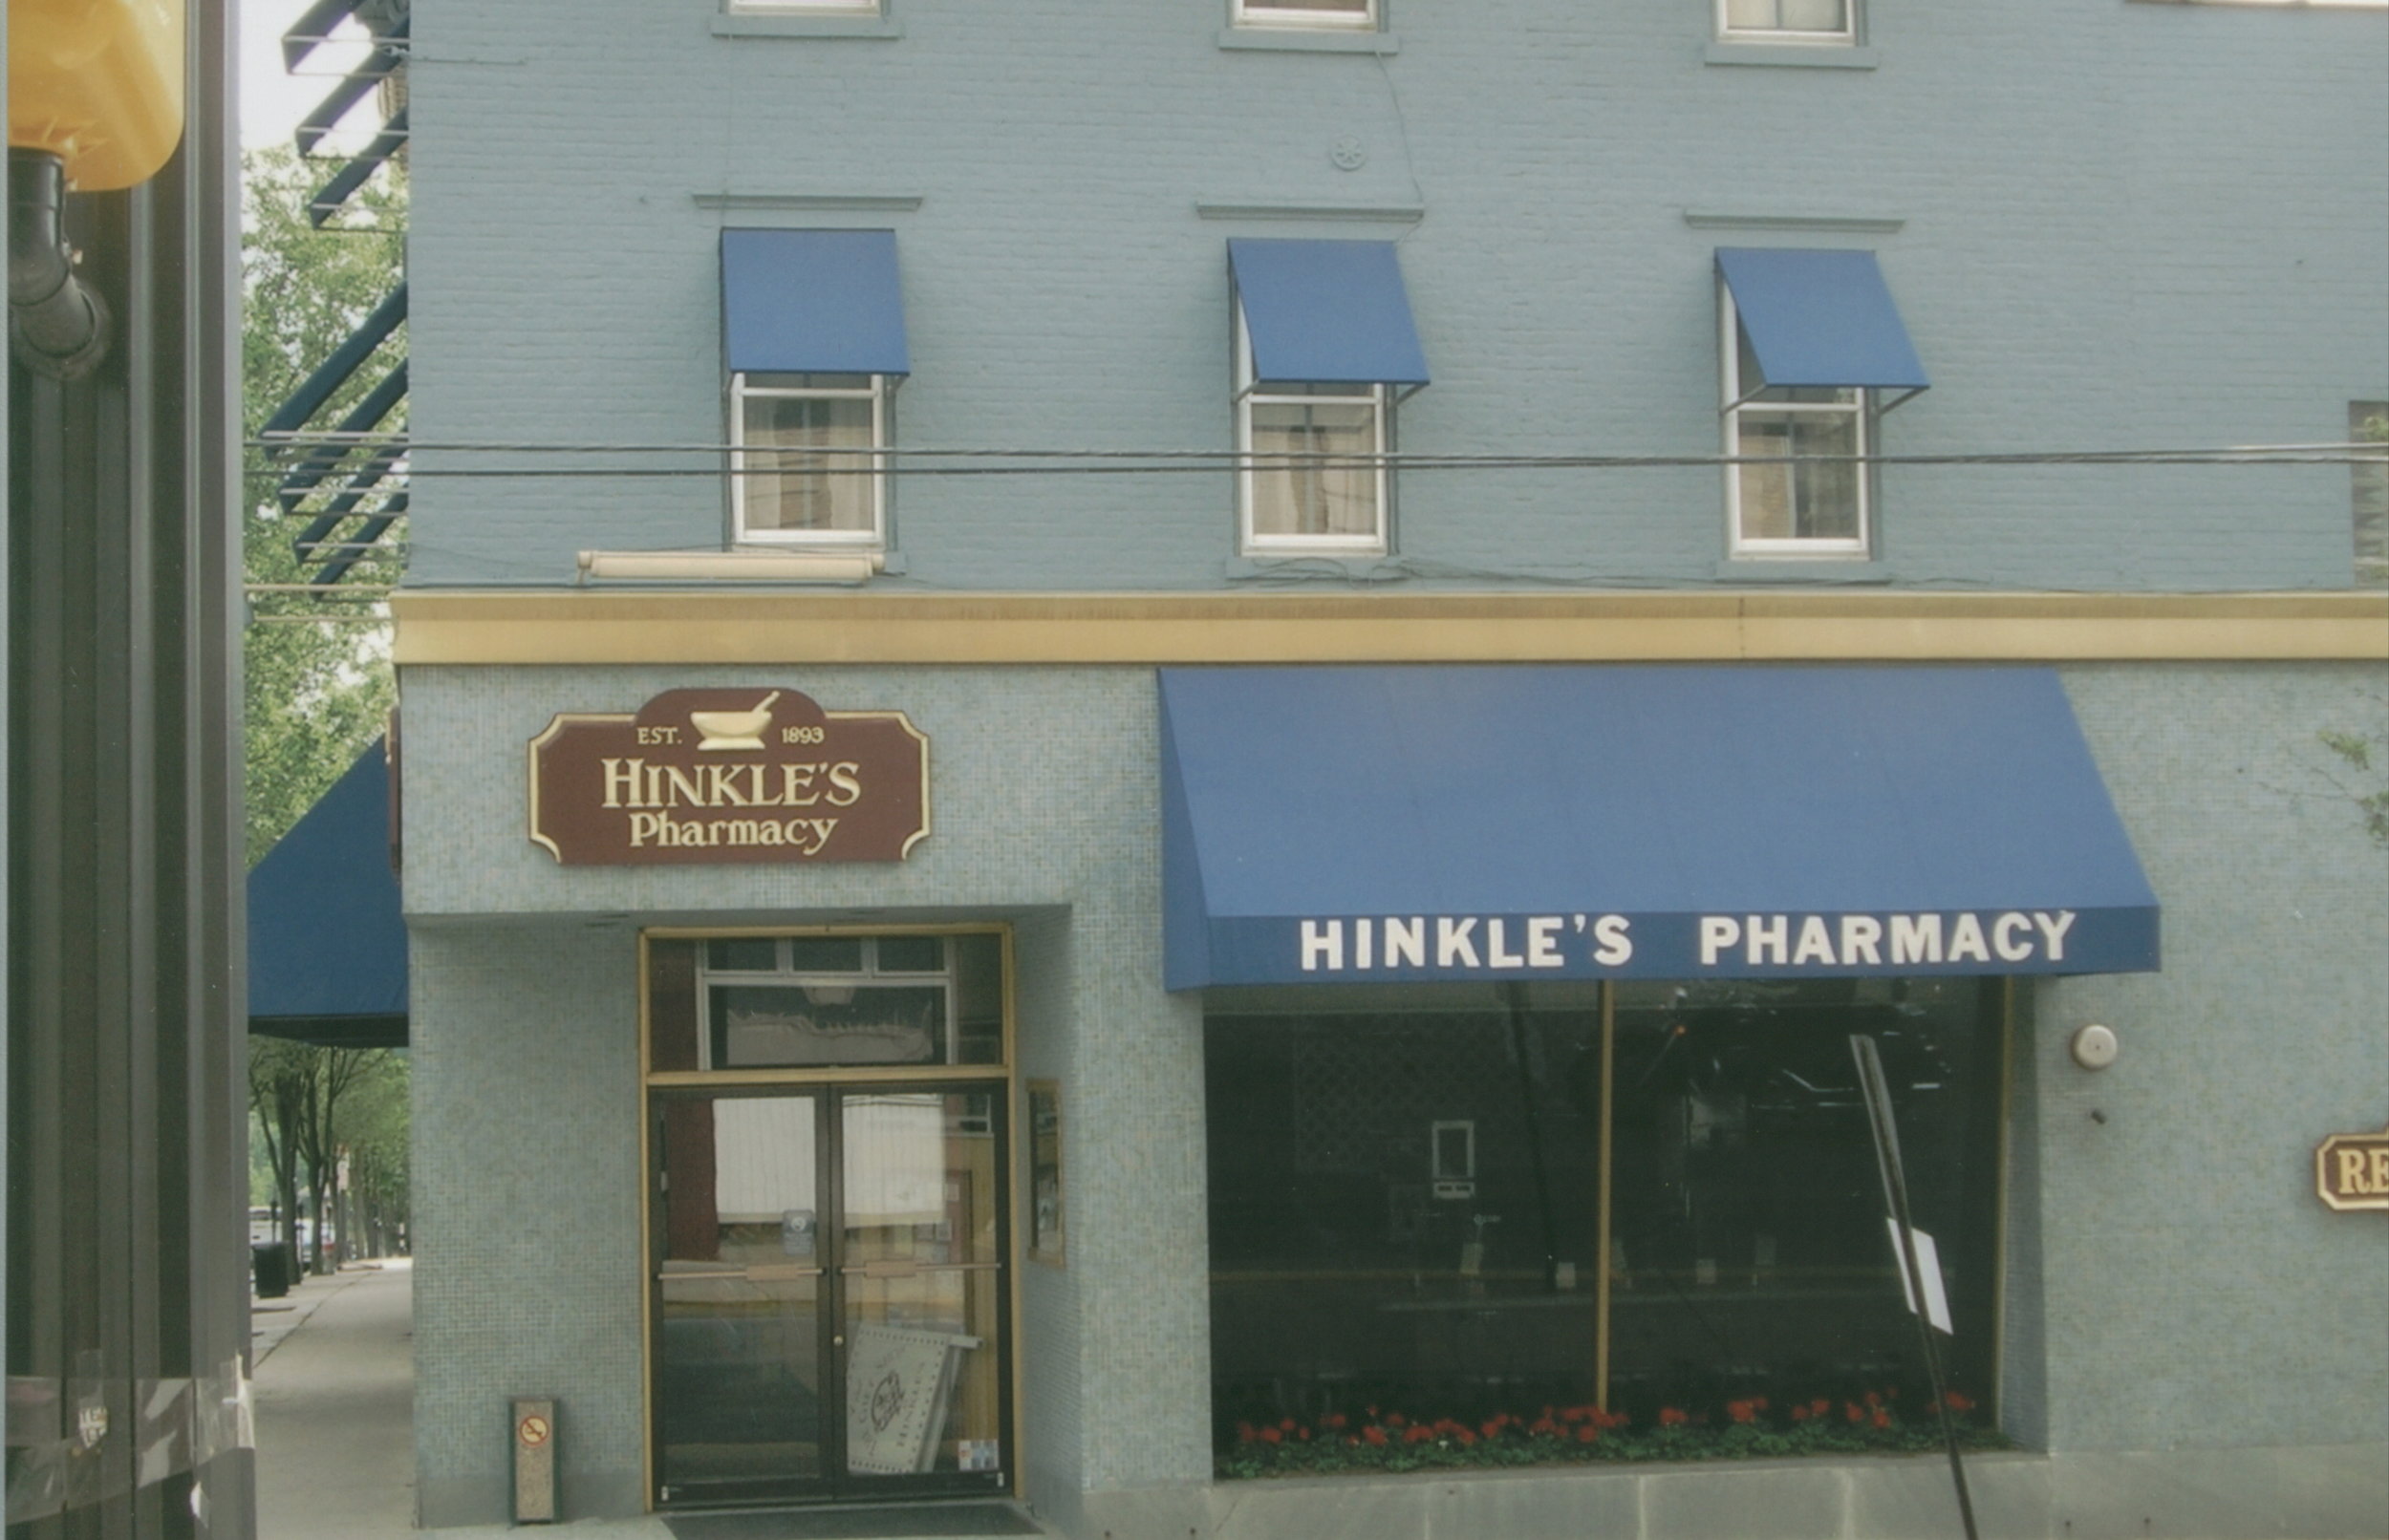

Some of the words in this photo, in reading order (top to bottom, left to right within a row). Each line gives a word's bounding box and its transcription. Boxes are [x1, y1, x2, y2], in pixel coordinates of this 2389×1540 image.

[636, 726, 683, 745] EST.
[782, 727, 825, 744] 1893
[601, 758, 861, 808] HINKLE'S
[629, 809, 839, 856] Pharmacy
[1301, 914, 1632, 971] HINKLE'S
[1701, 910, 2075, 965] PHARMACY
